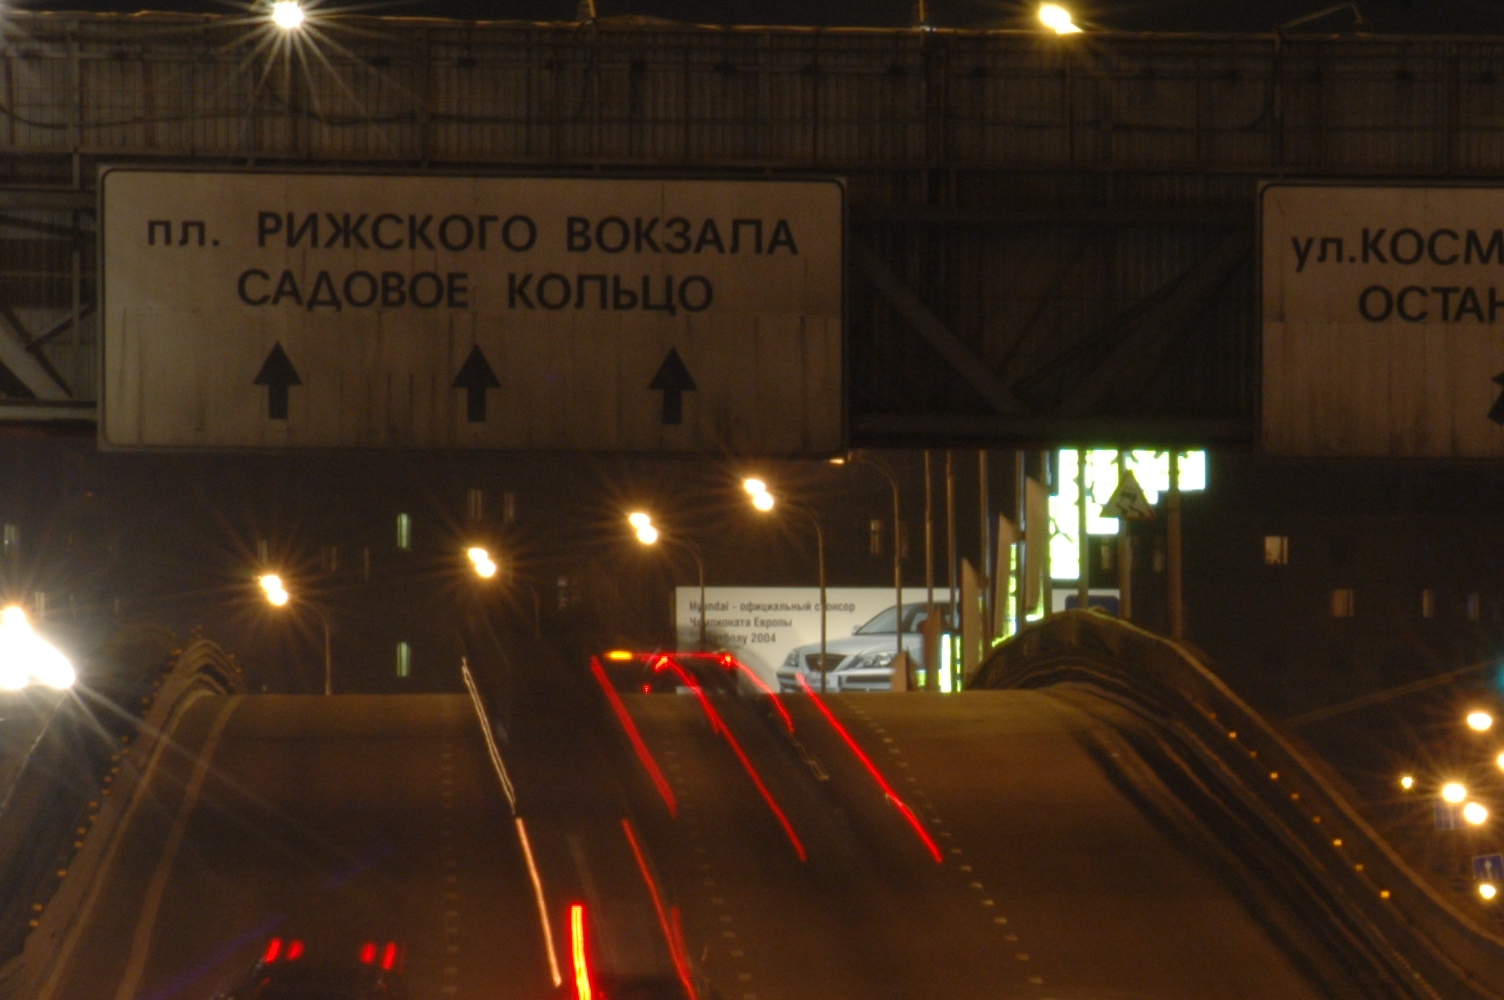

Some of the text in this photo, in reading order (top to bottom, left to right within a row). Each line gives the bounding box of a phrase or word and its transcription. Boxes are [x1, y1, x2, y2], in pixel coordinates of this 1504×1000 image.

[147, 211, 799, 255] пл. РИЖСКОГО ВОКЗАЛА
[237, 268, 714, 317] САДОВОЕ КОЛЬЦО
[740, 600, 812, 614] официальный
[814, 602, 856, 614] сонсор
[753, 616, 792, 630] Европы
[751, 632, 776, 644] 2004
